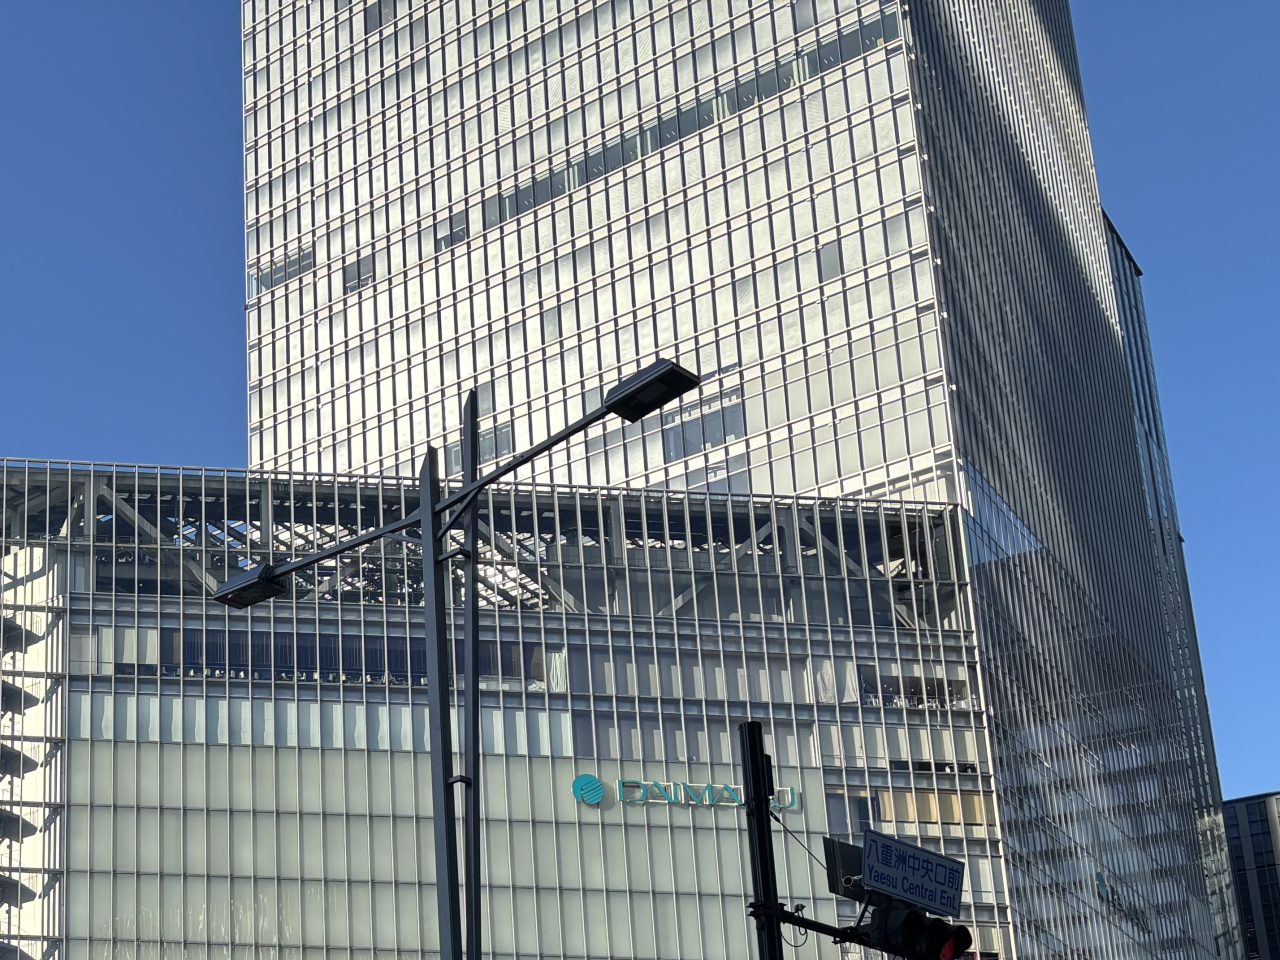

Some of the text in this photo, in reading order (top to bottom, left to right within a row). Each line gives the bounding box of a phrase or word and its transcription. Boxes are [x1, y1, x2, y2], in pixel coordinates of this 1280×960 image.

[616, 779, 796, 809] DAIMAU
[867, 839, 960, 891] 八重洲中央口前
[867, 863, 897, 889] Yaesu
[901, 876, 937, 903] Central
